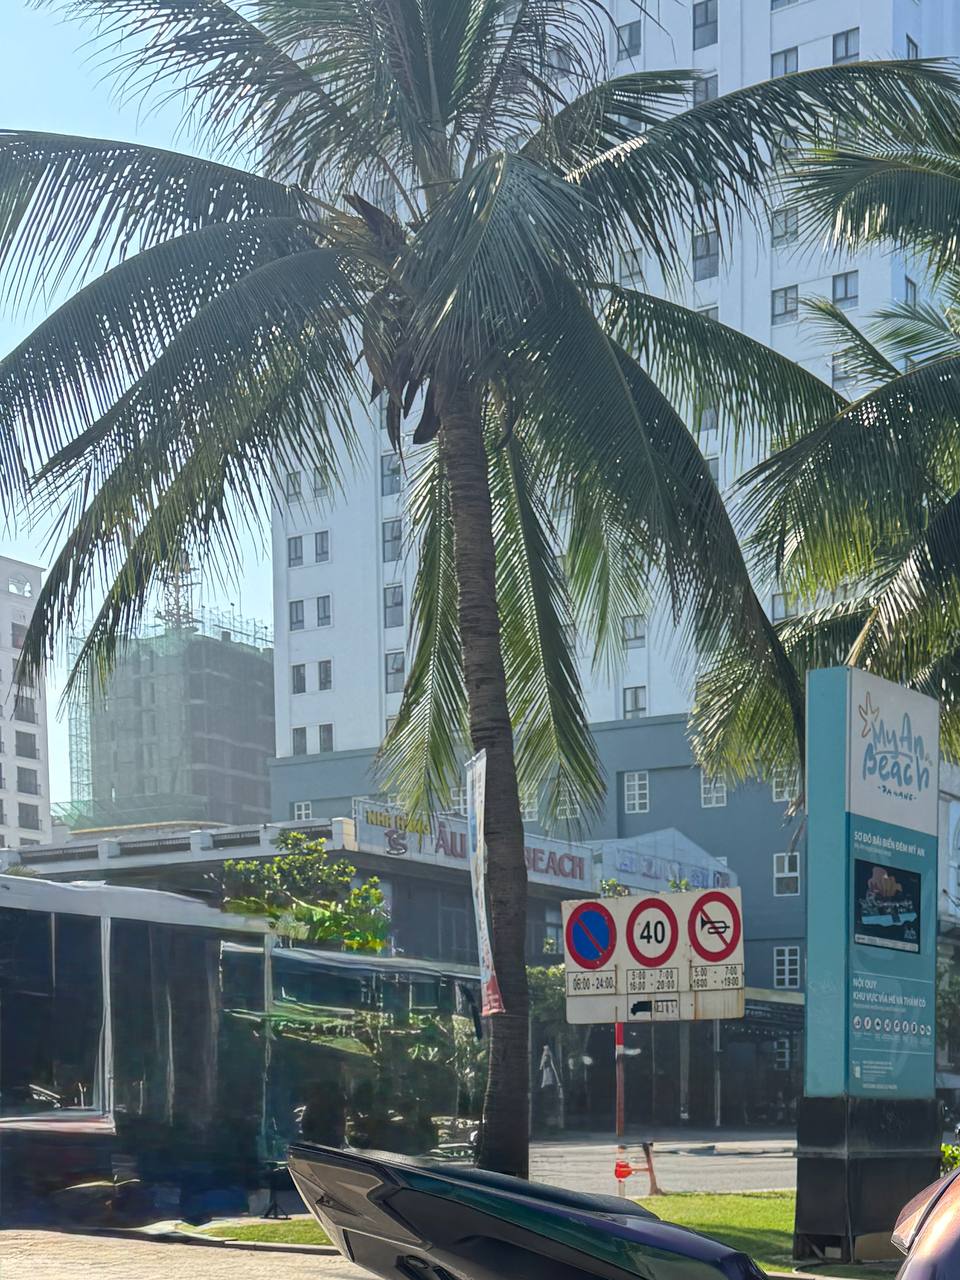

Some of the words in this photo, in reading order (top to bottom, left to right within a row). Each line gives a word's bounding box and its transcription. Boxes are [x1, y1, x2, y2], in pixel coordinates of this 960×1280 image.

[899, 712, 925, 760] An
[863, 742, 930, 792] Beach
[640, 920, 666, 944] 40
[596, 976, 613, 990] 24:00
